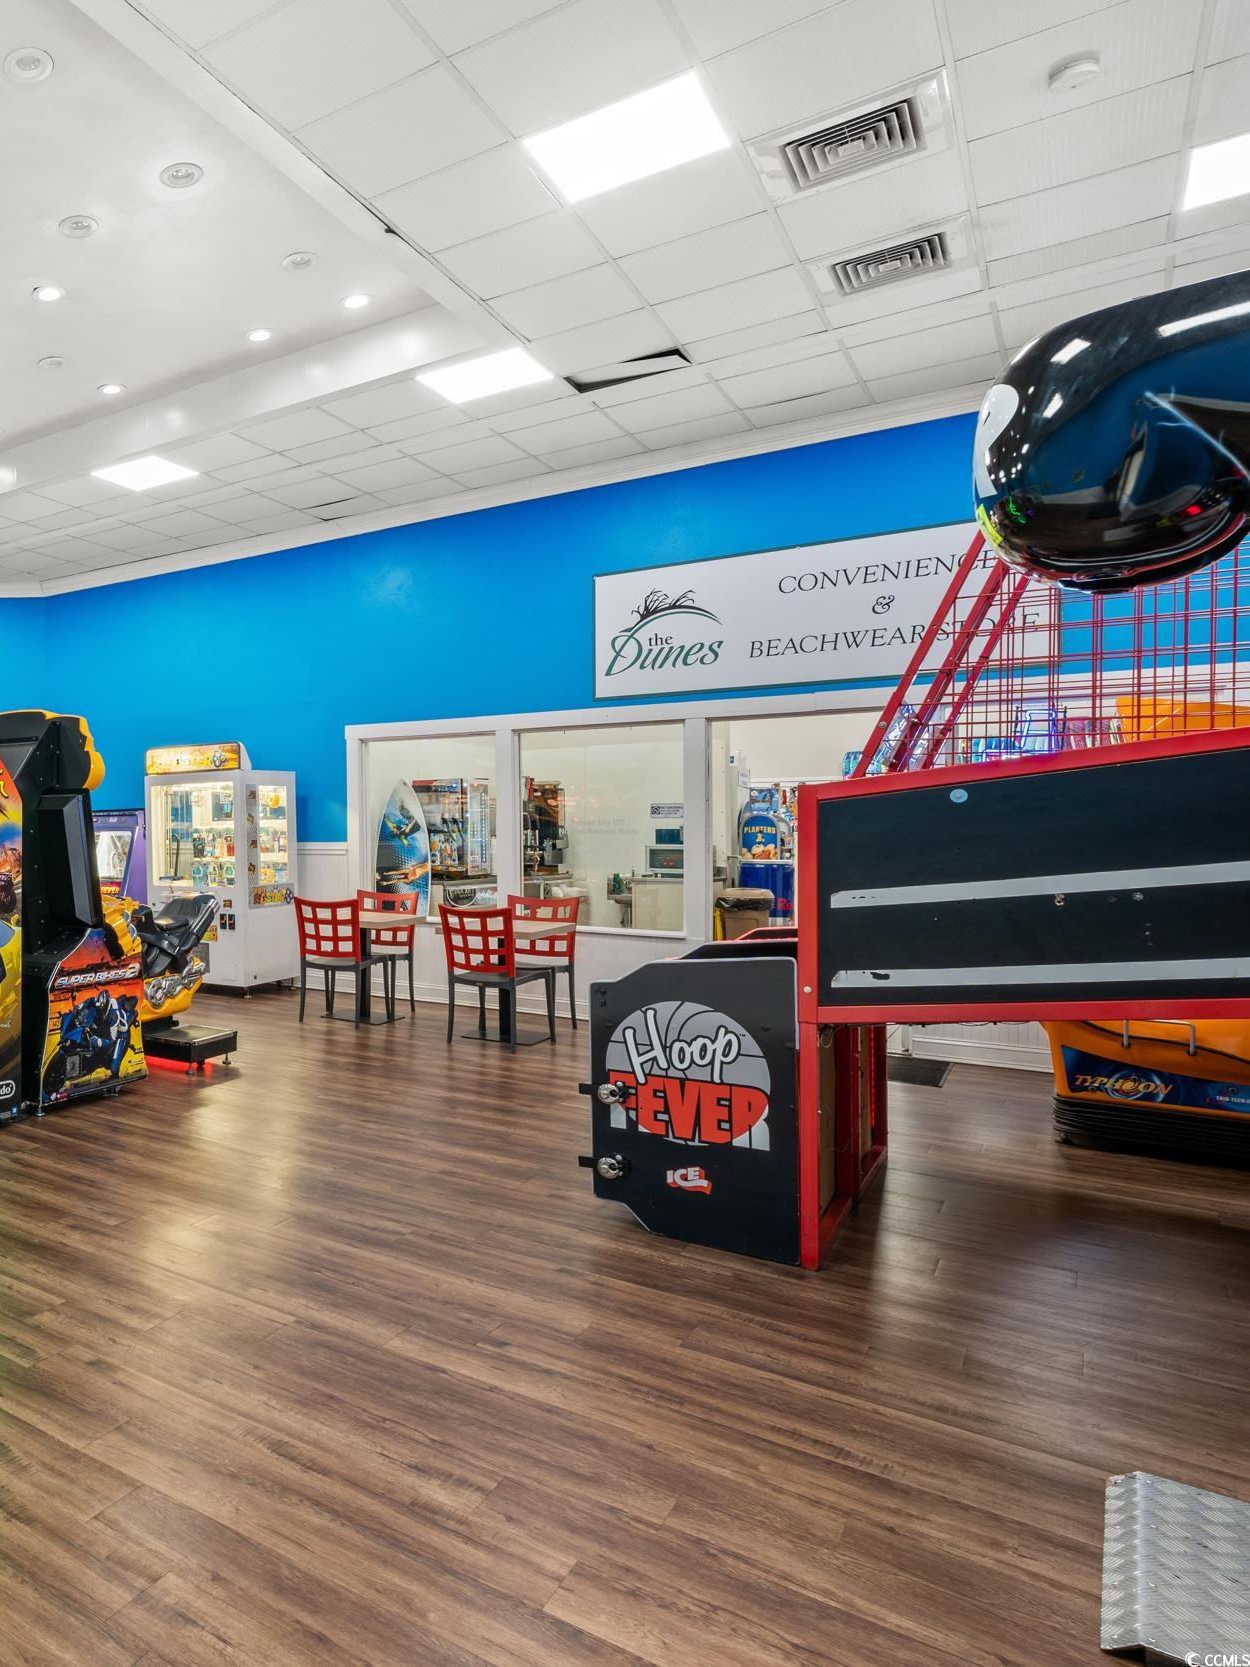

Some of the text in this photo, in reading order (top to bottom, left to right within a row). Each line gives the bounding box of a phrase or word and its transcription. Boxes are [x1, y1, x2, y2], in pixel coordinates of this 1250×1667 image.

[871, 594, 895, 615] &
[648, 633, 673, 646] the
[749, 624, 926, 658] BEACHWEAR
[605, 634, 724, 676] Dunes
[744, 826, 776, 834] PLANTERS
[625, 1010, 738, 1083] Hoop
[1073, 1074, 1174, 1096] TYPHOON
[609, 1070, 770, 1151] FEVER
[666, 1166, 709, 1188] ICE
